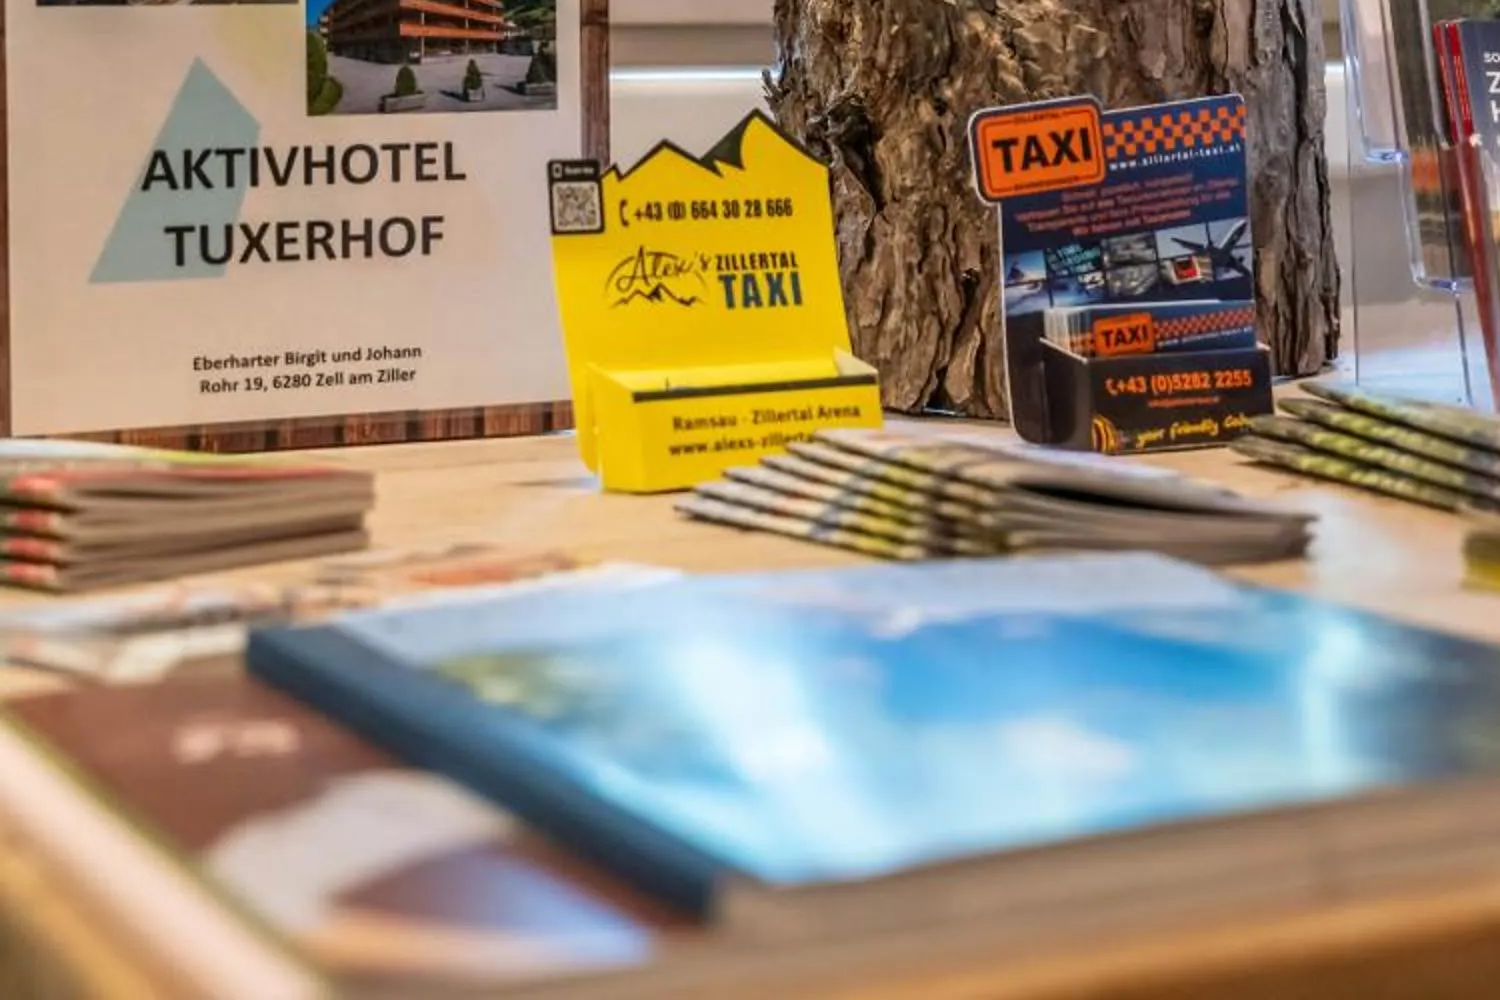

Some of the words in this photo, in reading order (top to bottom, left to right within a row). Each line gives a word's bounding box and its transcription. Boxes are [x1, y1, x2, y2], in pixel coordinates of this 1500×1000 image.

[991, 127, 1092, 174] TAXI
[141, 141, 467, 191] AKTIVHOTEL
[635, 201, 662, 222] +43
[691, 200, 718, 220] 664
[722, 199, 740, 219] 30
[767, 198, 793, 217] 666
[164, 215, 445, 266] TUXERHOF
[716, 252, 798, 272] ZILLERTAL
[718, 271, 803, 309] TAXI
[1102, 325, 1149, 348] TAXI
[193, 353, 280, 371] Eberharter
[285, 350, 327, 368] Birgit
[332, 348, 362, 363] und
[365, 346, 422, 361] Johann
[201, 378, 239, 394] Rohr
[244, 378, 268, 392] 19,
[273, 374, 311, 389] 6280
[316, 371, 344, 387] Zell
[349, 374, 373, 385] am
[377, 368, 416, 383] Ziller
[1117, 375, 1147, 393] +43
[1215, 370, 1252, 389] 2255
[673, 413, 737, 432] Ramsau
[752, 406, 813, 425] Zillertal
[818, 404, 861, 419] Arena
